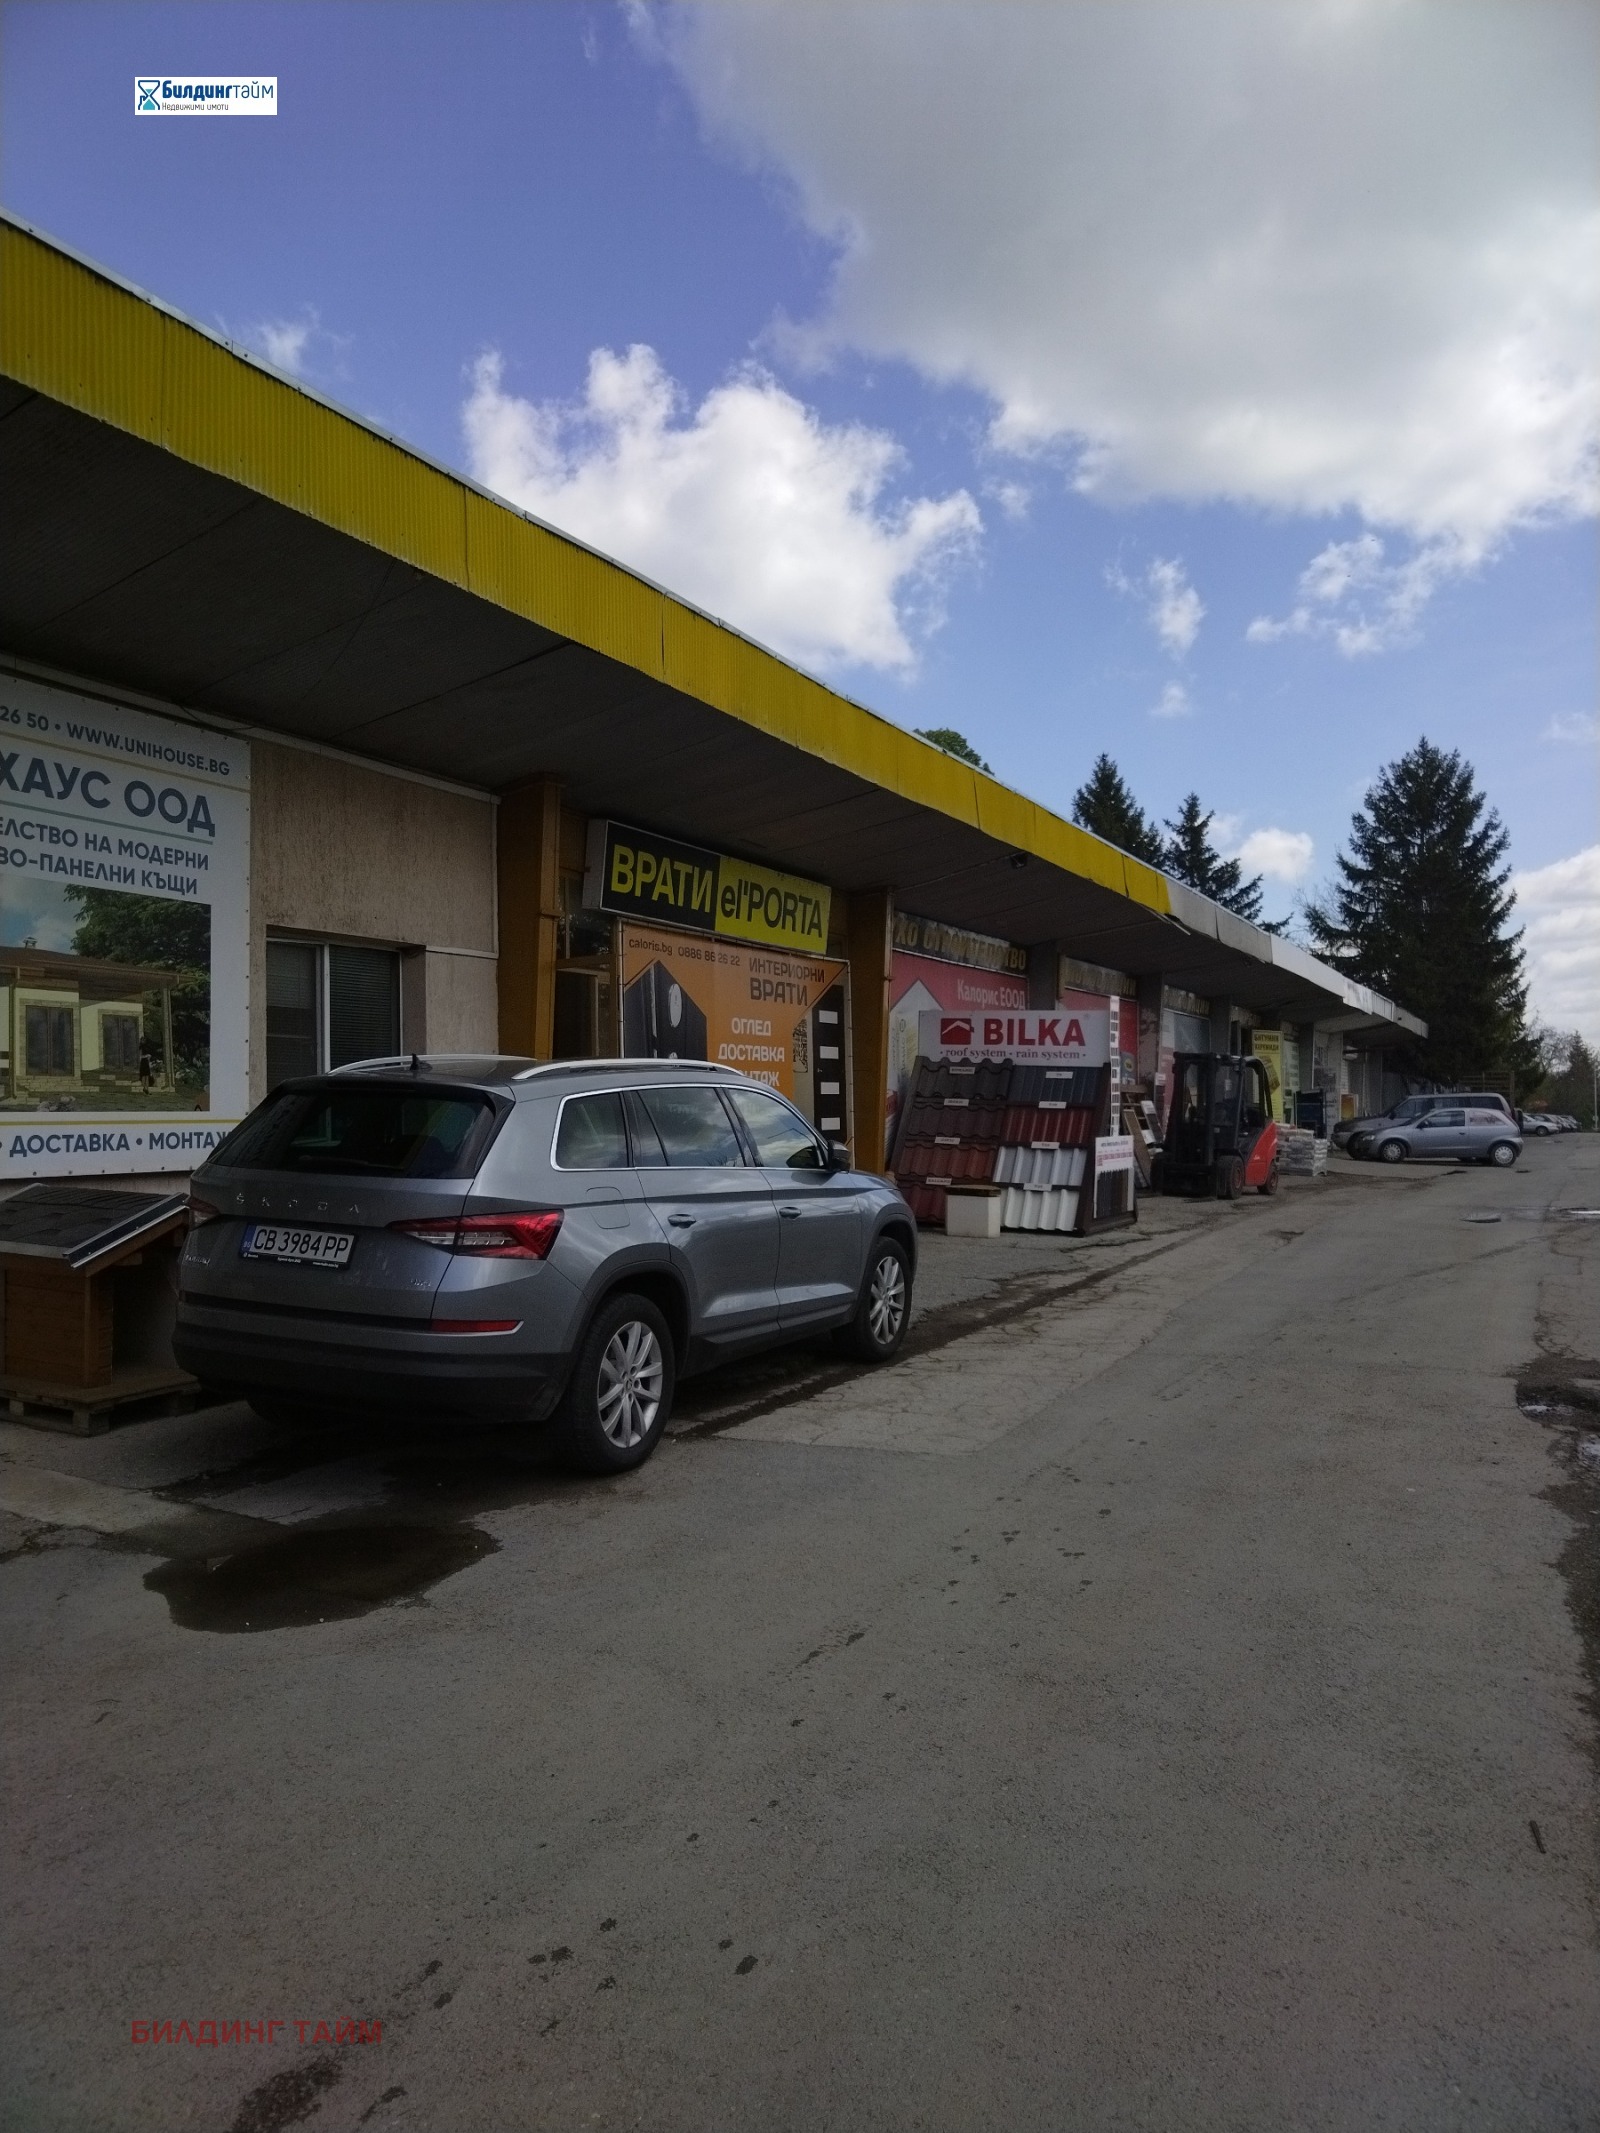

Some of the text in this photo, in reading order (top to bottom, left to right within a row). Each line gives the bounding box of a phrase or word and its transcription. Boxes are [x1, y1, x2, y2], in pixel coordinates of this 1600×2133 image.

[27, 713, 49, 731] 50
[67, 721, 230, 776] WWW.UNIHOUSE.BG
[124, 780, 216, 838] ООД
[85, 832, 112, 855] НА
[119, 840, 209, 871] МОДЕРНИ
[142, 871, 198, 896] КЪЩИ
[610, 843, 713, 914] ВРАТИ
[629, 938, 673, 956] caloris.bg
[678, 946, 702, 960] 0886
[705, 950, 716, 962] 86
[731, 955, 741, 966] 22
[749, 957, 825, 983] ИНТЕРИОРНИ
[750, 977, 808, 1006] ВРАТИ
[957, 979, 1026, 1012] Калорис ЕООД
[732, 1017, 771, 1036] ОГЛЕД
[983, 1018, 1086, 1046] BILKA
[718, 1043, 785, 1062] ДОСТАВКА
[946, 1047, 1080, 1061] roof system rain system
[10, 1132, 130, 1158] ДОСТАВКА
[278, 1231, 322, 1256] 3984
